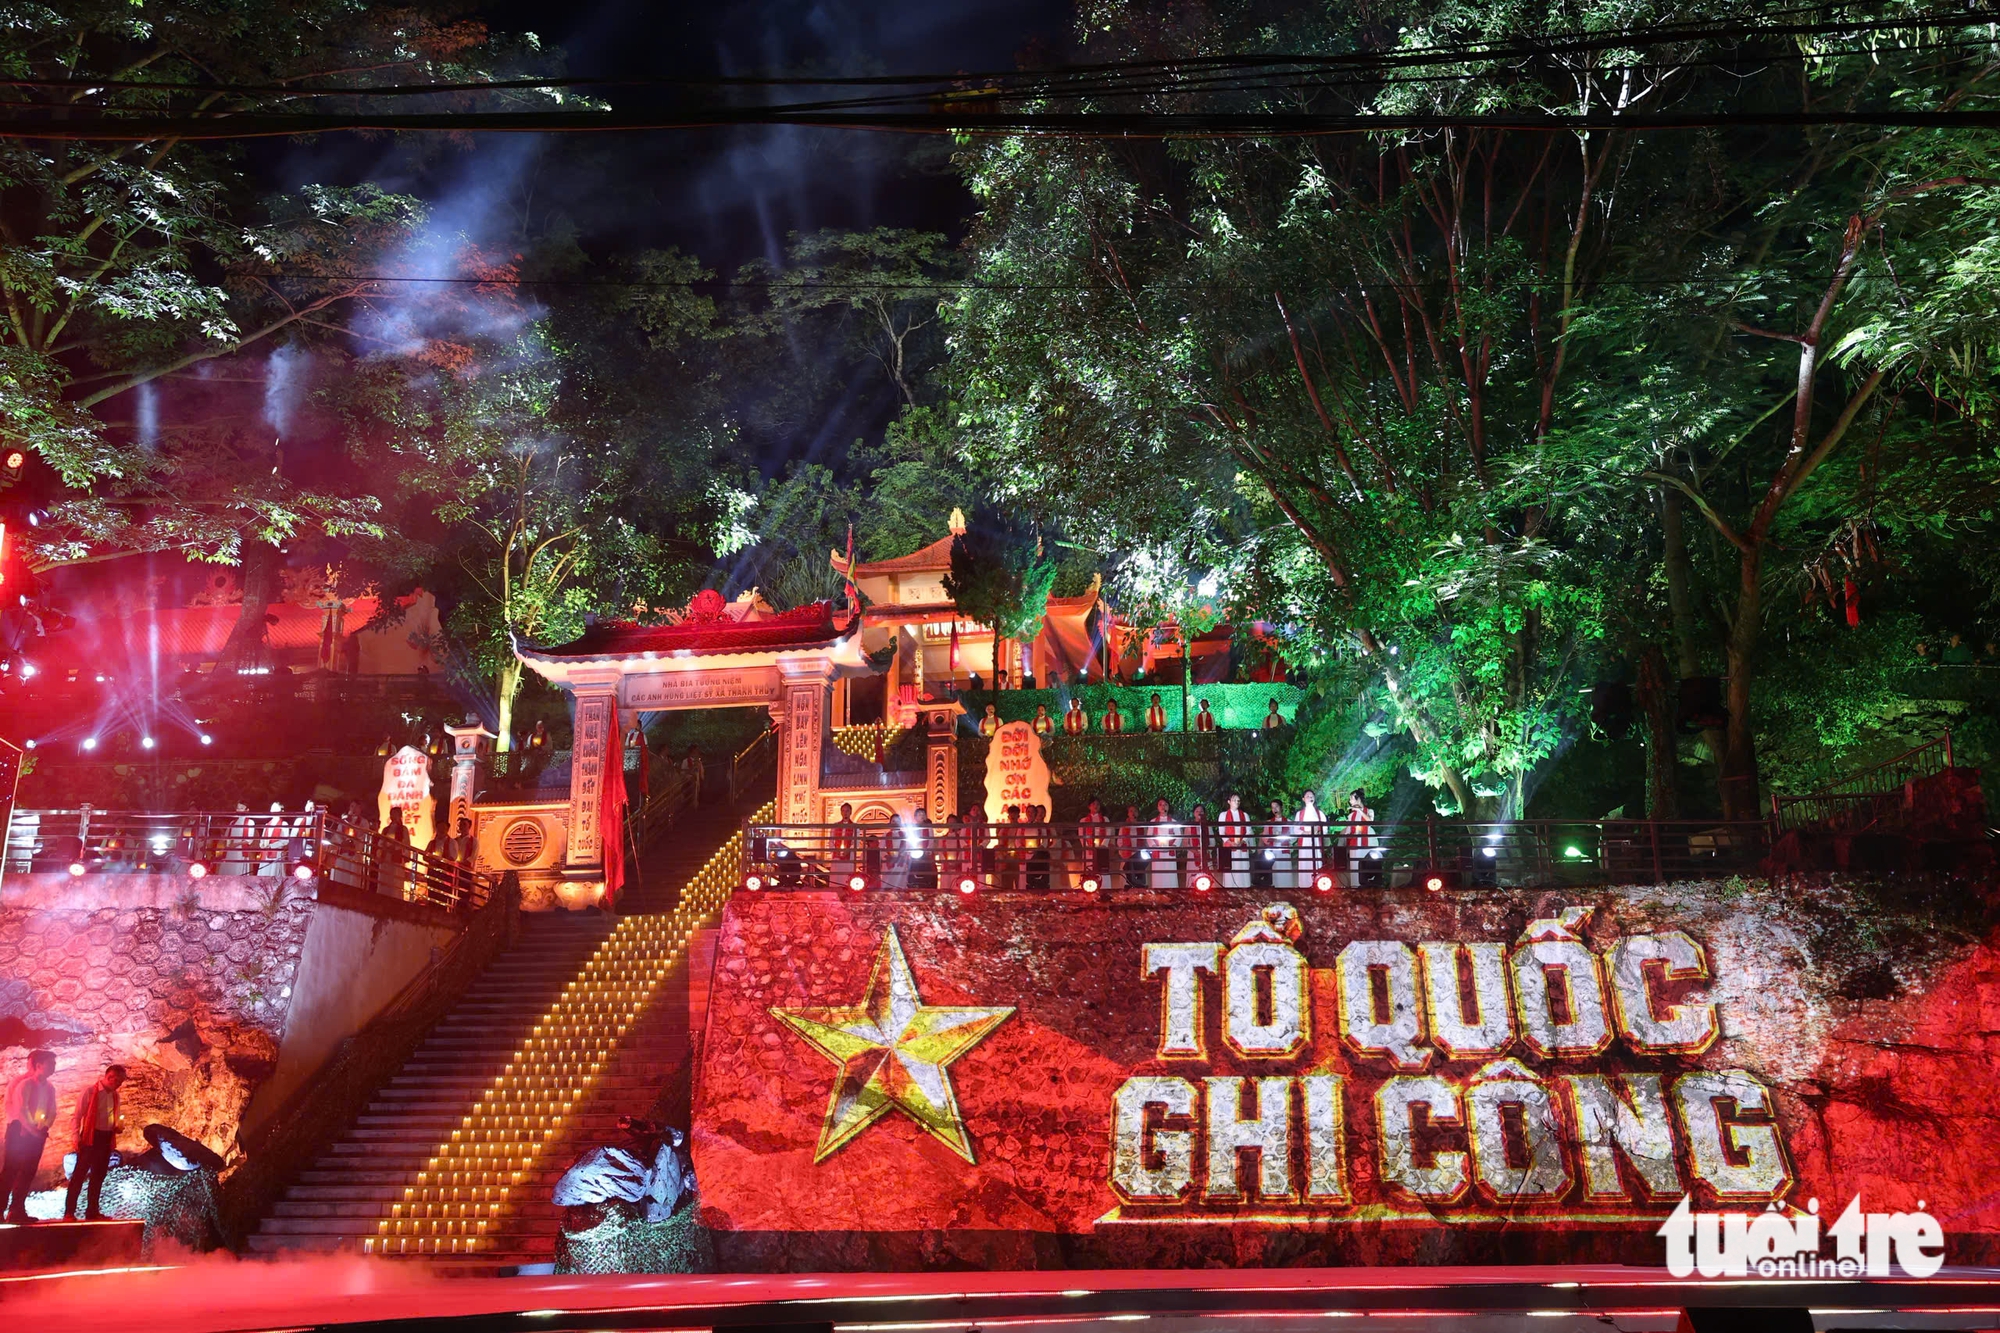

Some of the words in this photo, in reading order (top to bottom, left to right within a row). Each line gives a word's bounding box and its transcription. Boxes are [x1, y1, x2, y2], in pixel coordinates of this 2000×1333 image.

[680, 679, 693, 688] BIA
[647, 693, 662, 701] ANH
[1000, 756, 1032, 771] NHỚ
[1005, 773, 1027, 786] ƠN
[1000, 786, 1032, 800] CÁC
[1140, 903, 1308, 1063] TỔ
[1336, 905, 1722, 1070] QUỐC
[1107, 1073, 1351, 1207] GHI
[1373, 1056, 1795, 1206] CÔNG
